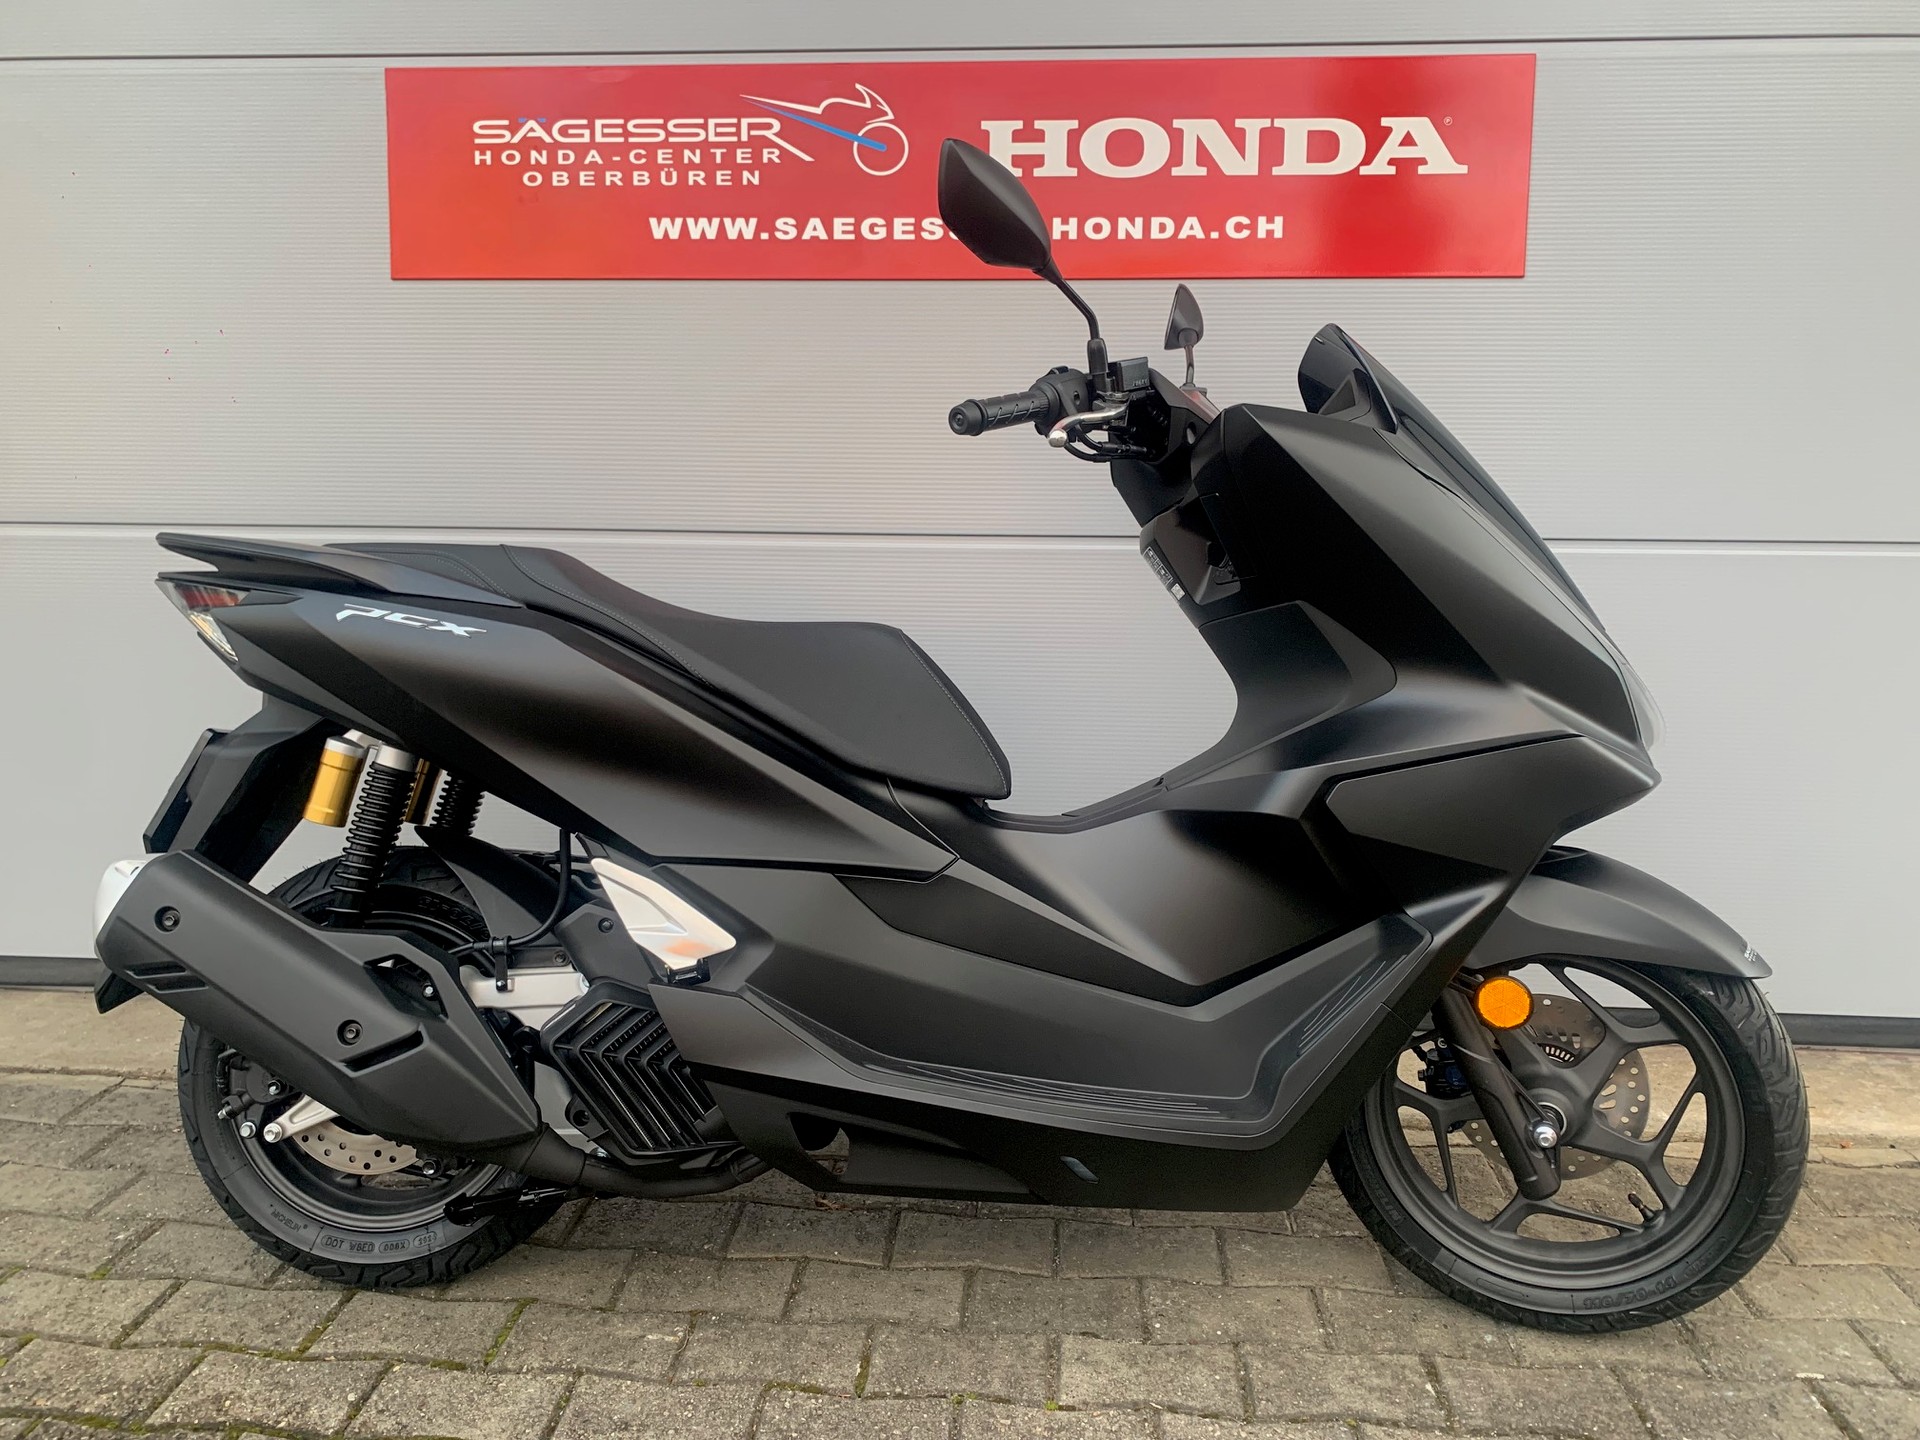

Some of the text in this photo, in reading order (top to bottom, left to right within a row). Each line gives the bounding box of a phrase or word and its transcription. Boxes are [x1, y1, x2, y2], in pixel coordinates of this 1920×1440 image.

[473, 117, 815, 162] SÄGESSER
[980, 116, 1469, 179] HONDA
[474, 148, 782, 166] HONDA-CENTER
[522, 168, 760, 187] OBERBÜREN
[648, 215, 1284, 241] WWW.SAEGESHONDA.CH
[335, 603, 488, 638] PCX
